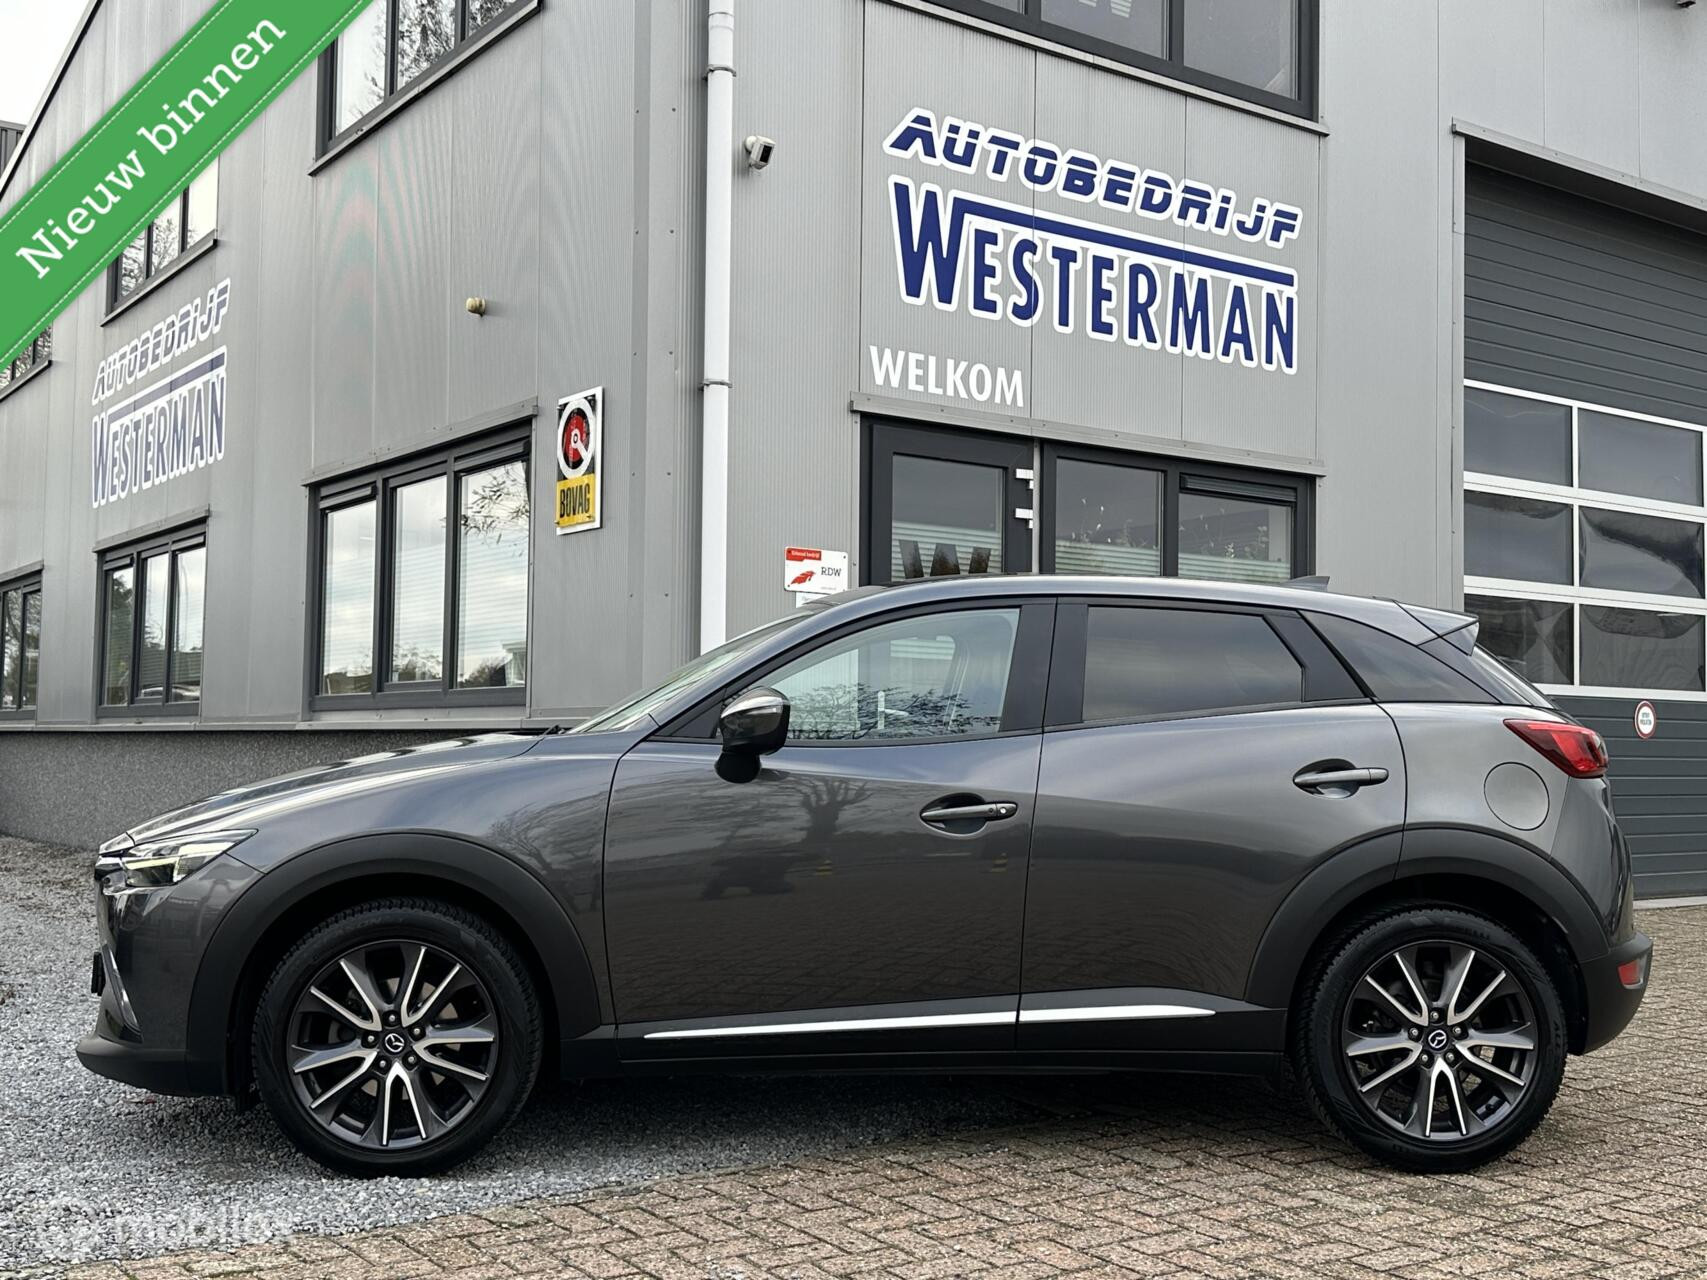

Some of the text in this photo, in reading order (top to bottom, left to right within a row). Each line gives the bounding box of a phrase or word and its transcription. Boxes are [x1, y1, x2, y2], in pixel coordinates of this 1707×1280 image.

[889, 175, 1297, 374] WESTERMAN
[869, 345, 1024, 407] WELKOM
[92, 346, 227, 508] WESTERMAN
[559, 482, 591, 518] BOVAG
[821, 566, 842, 577] RDW
